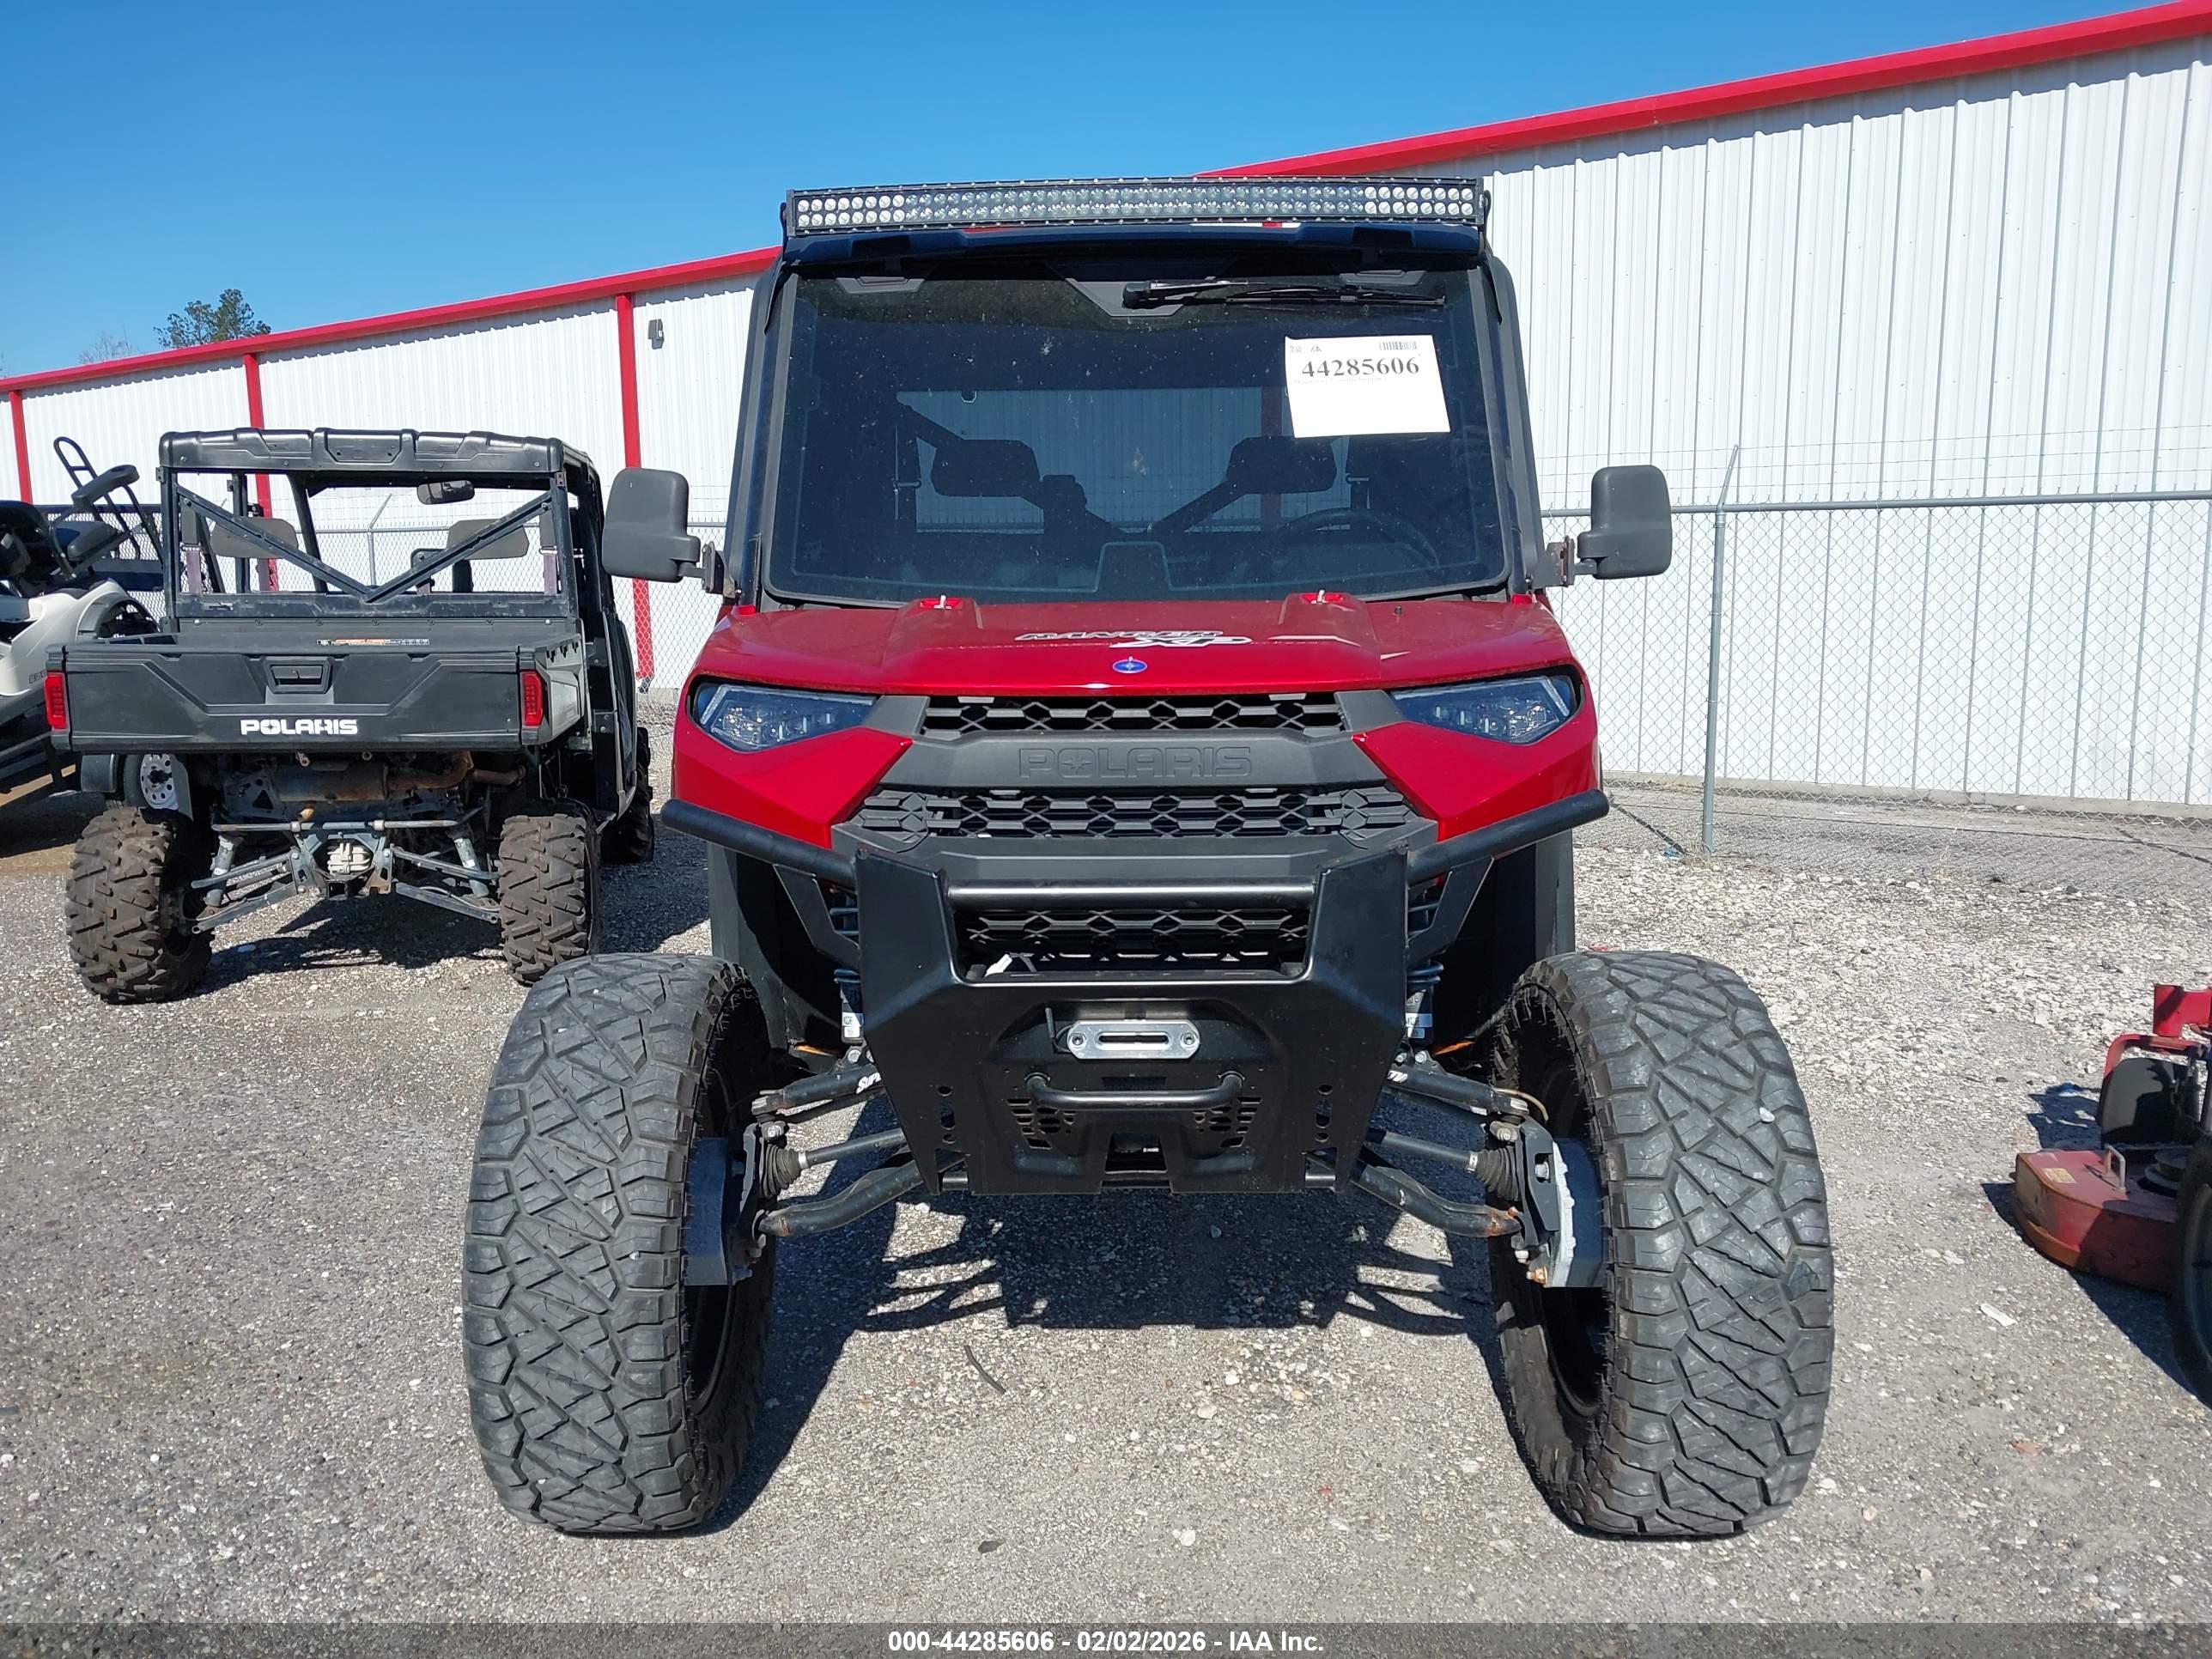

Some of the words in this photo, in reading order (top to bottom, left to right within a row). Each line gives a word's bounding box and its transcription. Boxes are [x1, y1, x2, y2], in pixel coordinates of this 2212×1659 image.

[1302, 357, 1419, 378] 44285606
[240, 718, 358, 736] POLARIS
[1018, 746, 1252, 778] POLARIS
